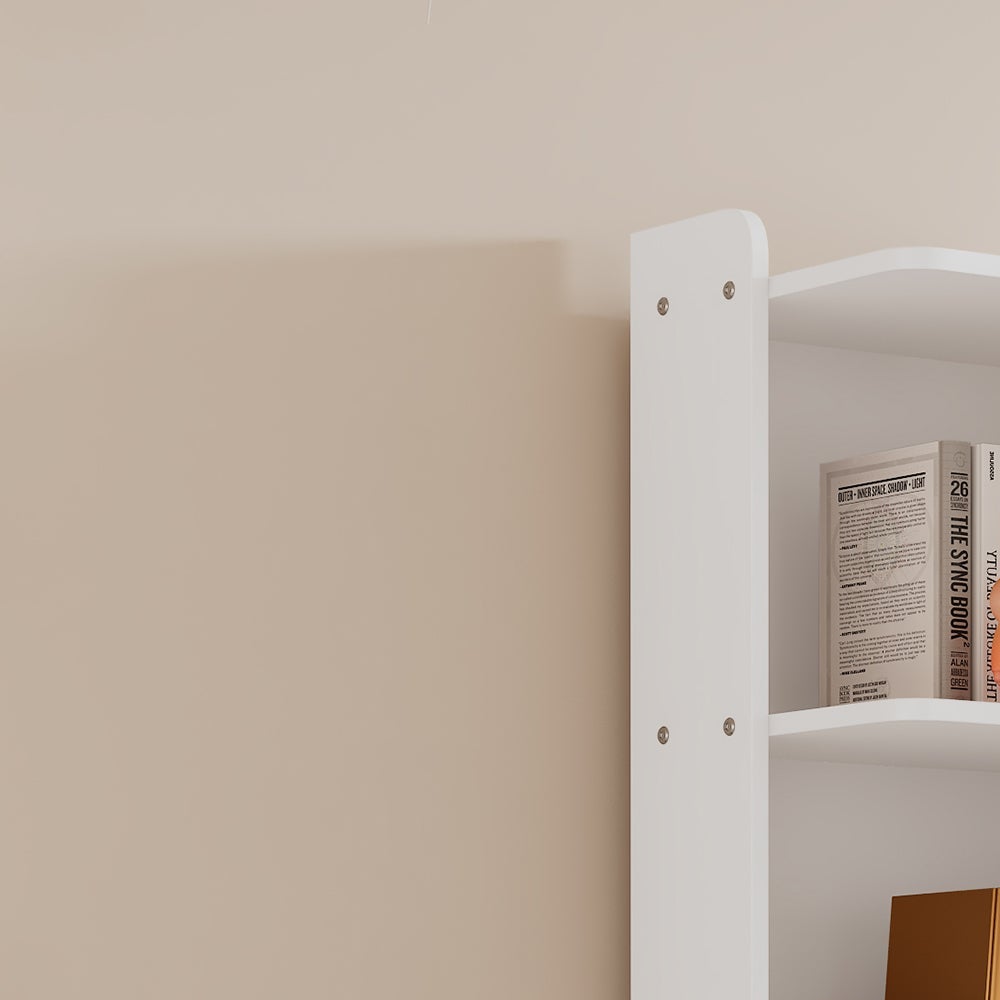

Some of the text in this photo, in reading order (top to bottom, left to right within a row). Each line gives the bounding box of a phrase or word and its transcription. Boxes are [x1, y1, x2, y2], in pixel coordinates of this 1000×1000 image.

[837, 490, 853, 503] OUTER
[857, 486, 872, 499] INNER
[887, 480, 909, 494] SHADOW
[911, 476, 926, 490] LIGHT
[950, 480, 969, 497] 26
[950, 515, 969, 546] THE
[950, 549, 969, 593] SYNC
[950, 658, 969, 667] ALAN
[950, 677, 969, 687] GREEN
